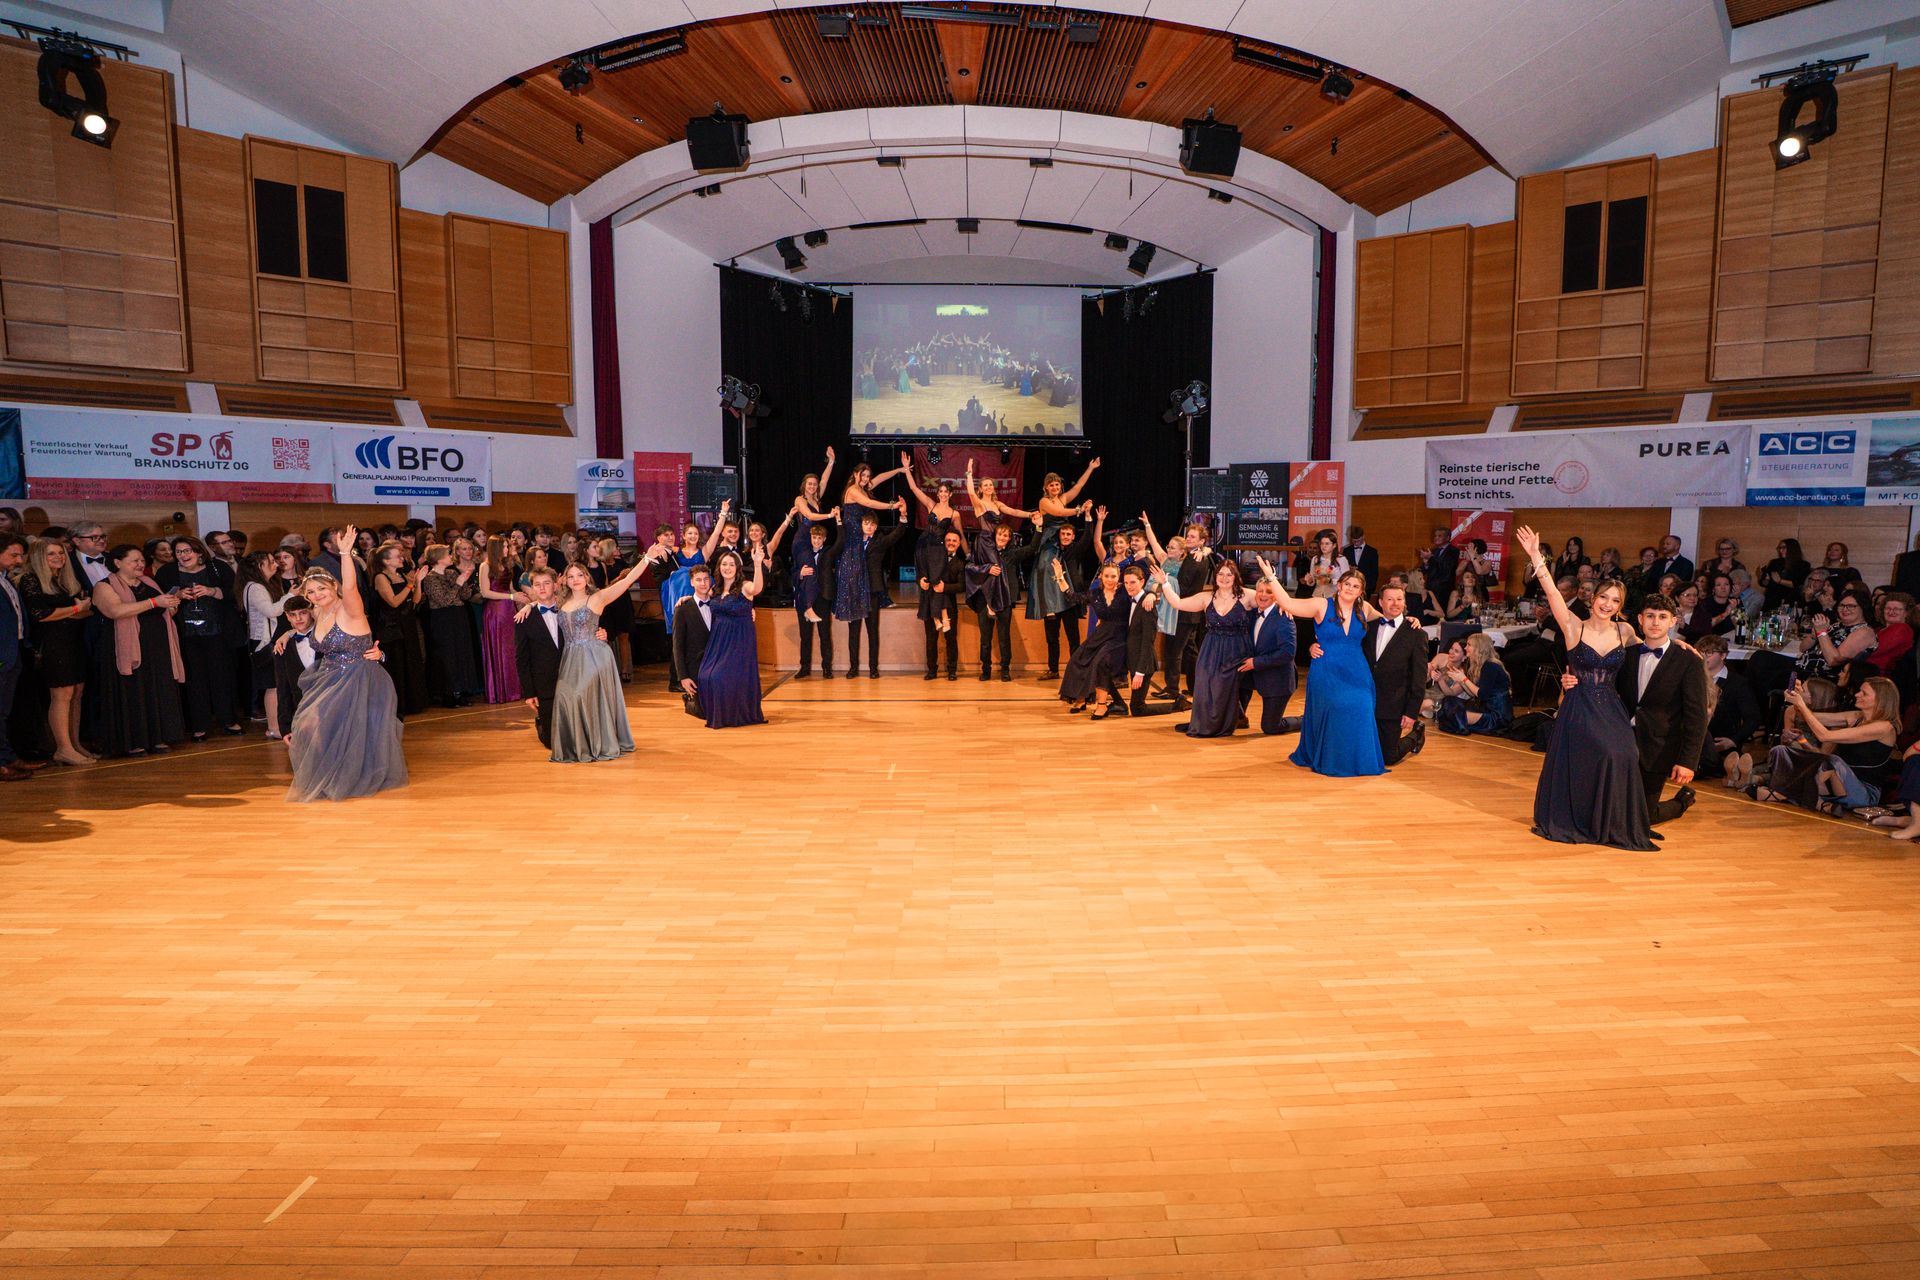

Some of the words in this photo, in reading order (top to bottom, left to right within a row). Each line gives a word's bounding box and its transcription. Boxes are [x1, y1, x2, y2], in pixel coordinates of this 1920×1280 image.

[30, 440, 91, 449] Feuerlöscher
[94, 442, 128, 450] Verkauf
[150, 432, 201, 457] SP
[1762, 435, 1850, 452] ACC
[31, 448, 92, 456] Feuerlöscher
[95, 449, 132, 458] Wartung
[1639, 440, 1730, 458] PUREA
[398, 446, 464, 472] BFO
[134, 458, 230, 470] BRANDSCHUTZ
[233, 462, 249, 471] OG
[1439, 464, 1483, 474] Reinste
[1486, 461, 1540, 472] tierische
[1761, 462, 1849, 471] STEUERBERATUNG
[601, 469, 624, 478] BFO
[1439, 476, 1488, 486] Proteine
[1491, 475, 1515, 485] und
[1519, 475, 1557, 485] Fette.
[1249, 489, 1270, 497] ALTE
[1438, 490, 1471, 500] Sonst
[1474, 489, 1514, 499] nichts.
[1755, 493, 1850, 502] www.acc-beratung.at
[1294, 499, 1337, 508] GEMEINSAM
[1310, 507, 1337, 516] SICHER
[1294, 515, 1337, 524] FEUERWEHR
